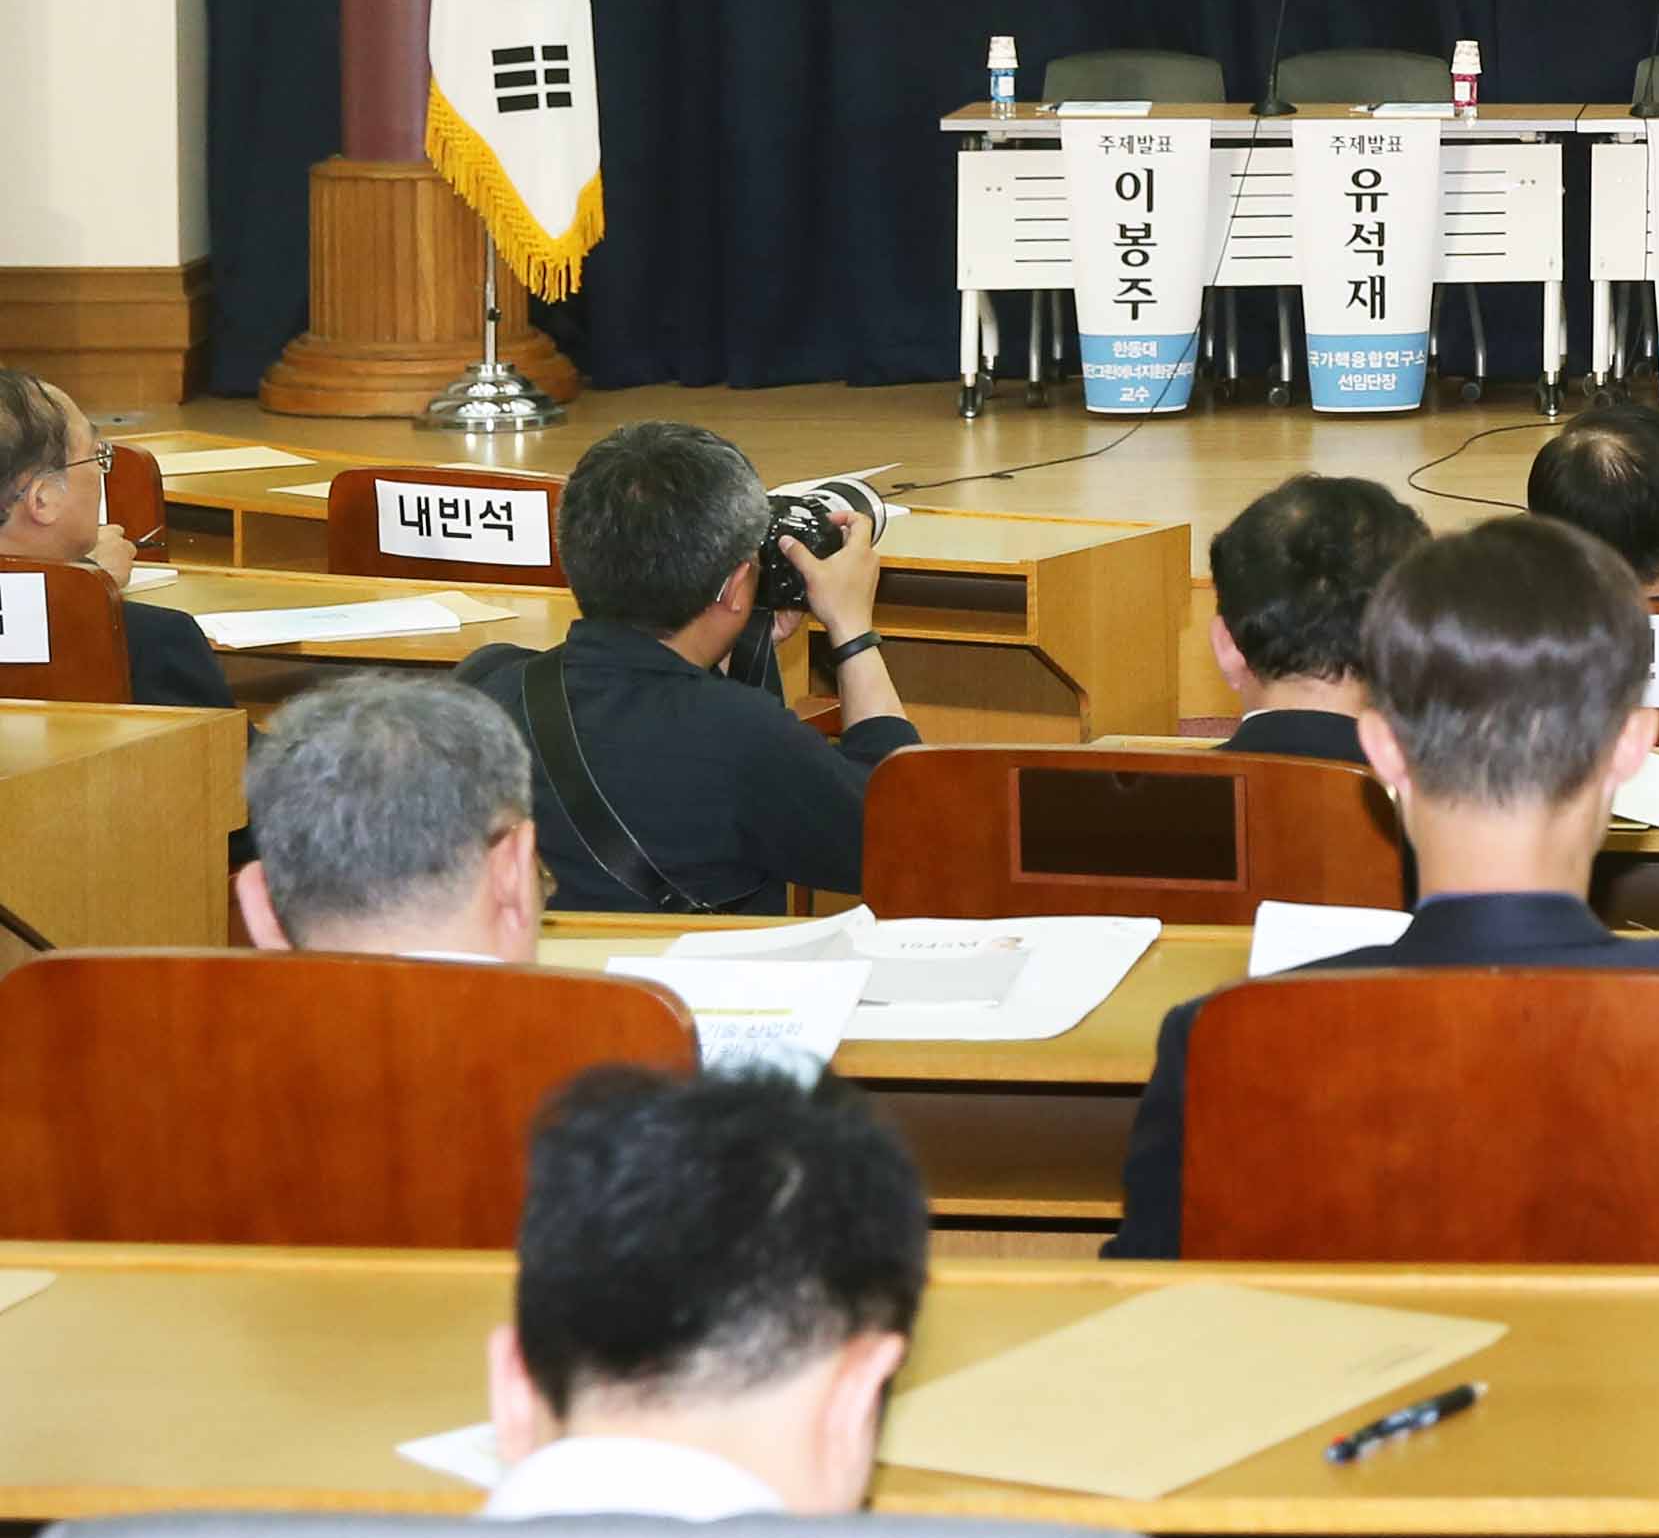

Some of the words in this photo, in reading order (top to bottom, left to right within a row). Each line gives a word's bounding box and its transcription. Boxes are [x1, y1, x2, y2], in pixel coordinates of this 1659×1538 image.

[1098, 134, 1172, 155] 주제발표
[1331, 134, 1403, 155] 주제발표
[1113, 168, 1157, 320] 이봉주
[1344, 169, 1388, 320] 유석재
[1120, 386, 1150, 402] 교수
[399, 493, 515, 542] 내빈석
